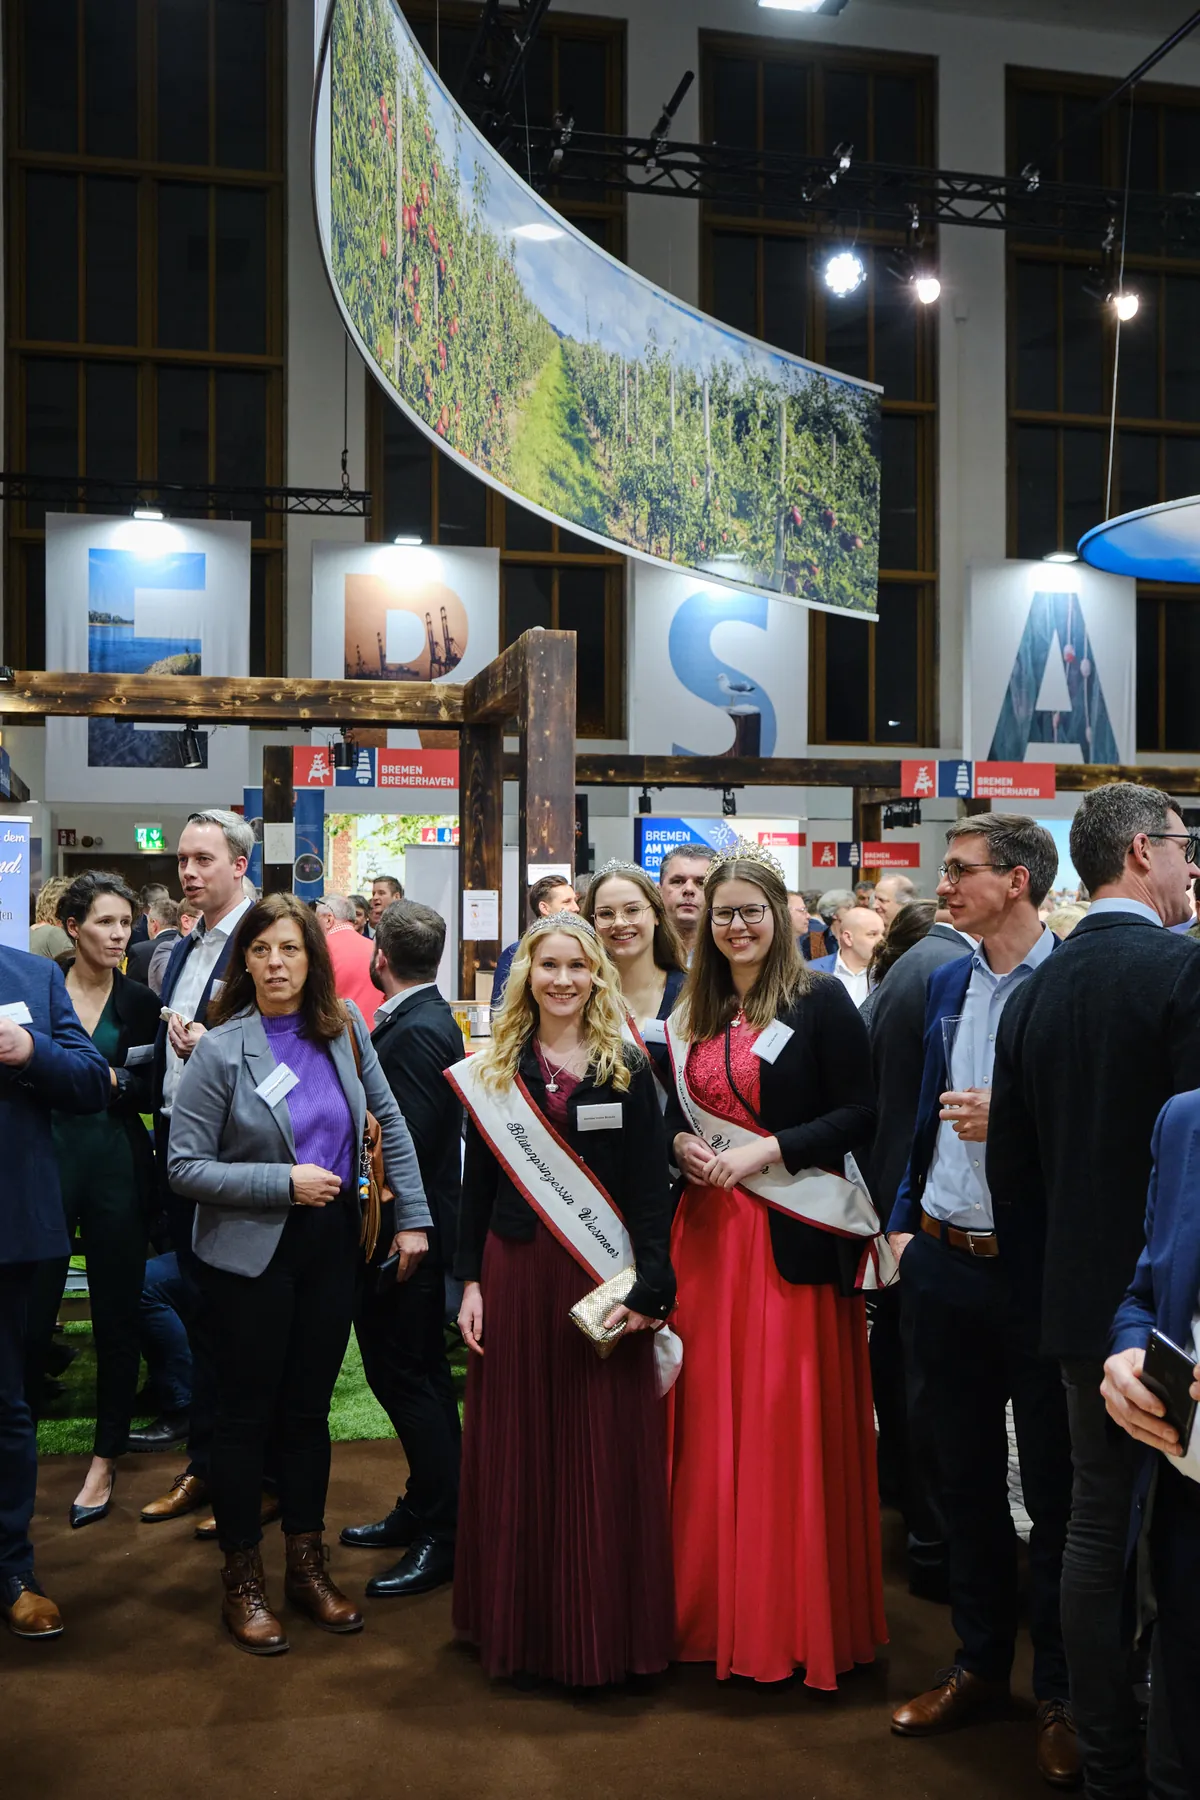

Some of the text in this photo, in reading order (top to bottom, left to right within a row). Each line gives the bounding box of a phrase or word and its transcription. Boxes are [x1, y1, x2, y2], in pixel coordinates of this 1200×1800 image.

[88, 548, 208, 767] E
[668, 589, 777, 758] S
[987, 591, 1120, 763] A
[381, 764, 423, 775] BREMEN
[381, 775, 454, 786] BREMERHAVEN
[977, 776, 1013, 786] BREMEN
[977, 787, 1040, 797] BREMERHAVEN
[4, 829, 26, 843] dem
[645, 830, 691, 842] BREMEN
[644, 843, 662, 854] AM
[506, 1122, 620, 1259] Blütenprinzessin Wiesmoor
